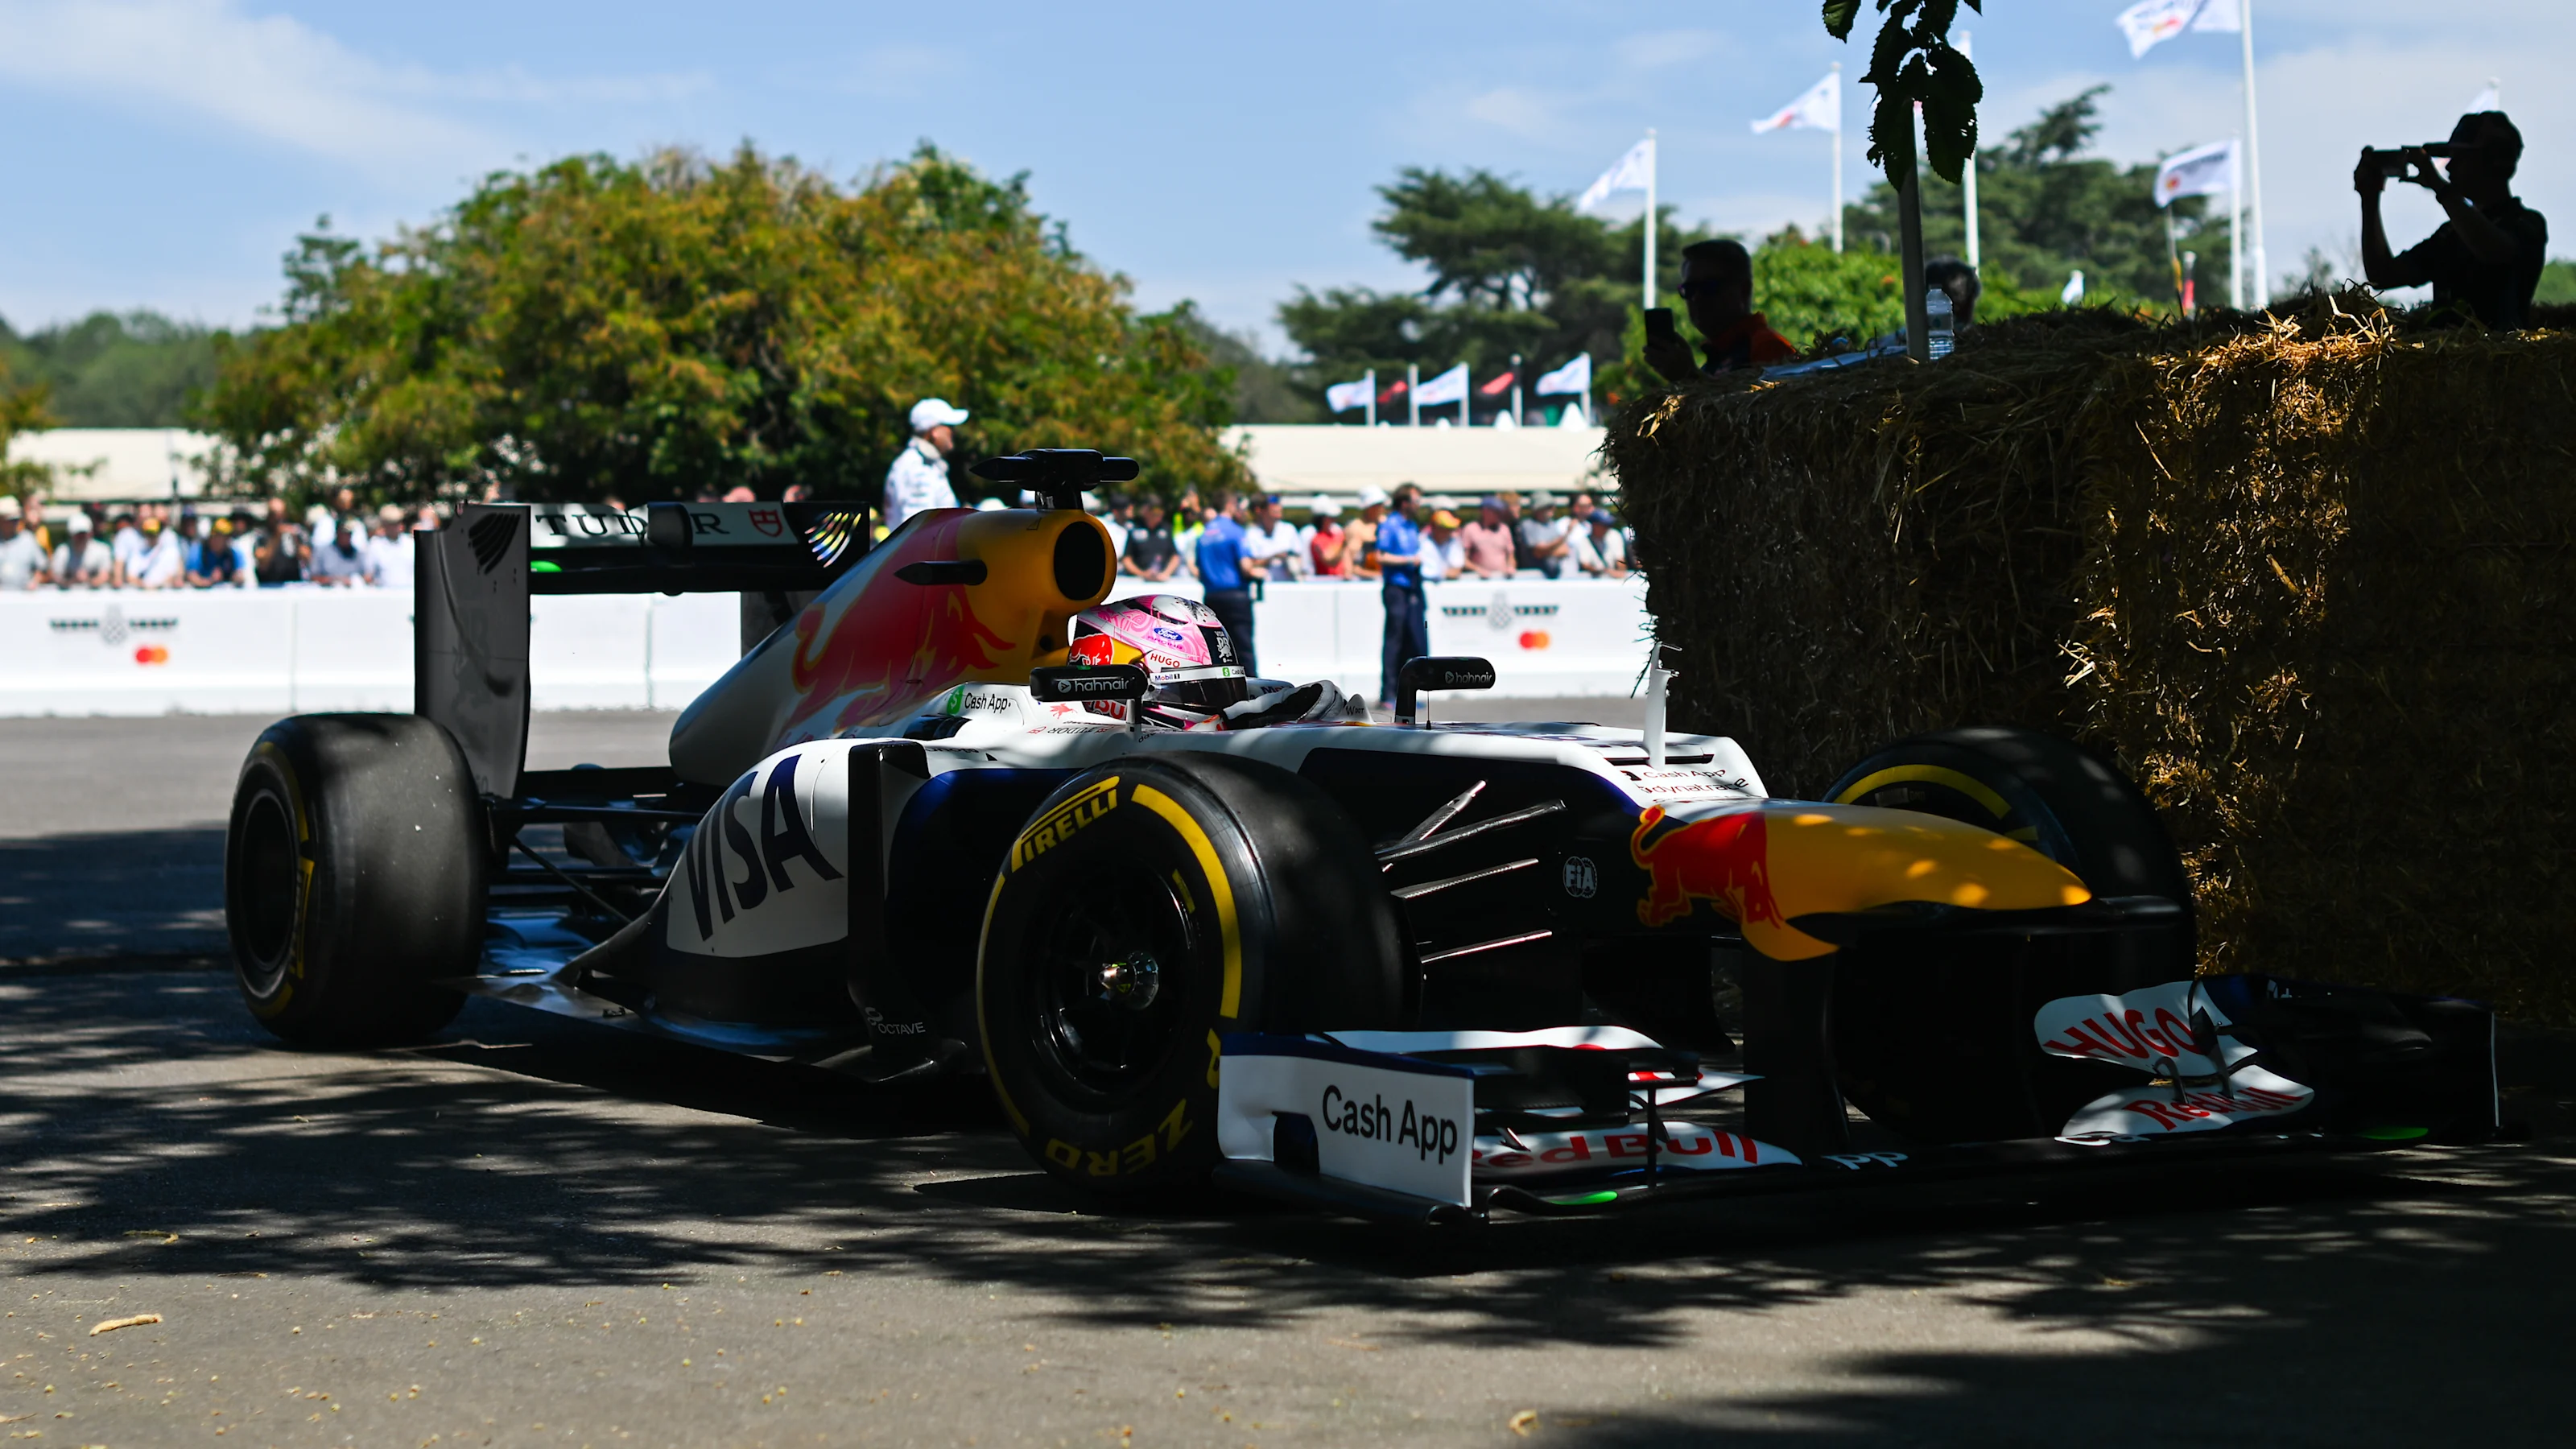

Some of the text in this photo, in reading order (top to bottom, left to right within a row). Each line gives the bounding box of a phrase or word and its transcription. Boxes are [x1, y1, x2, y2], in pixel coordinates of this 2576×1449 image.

[536, 512, 731, 537] TUDR
[1158, 628, 1179, 641] Ford
[1150, 653, 1180, 668] HUGO
[1075, 678, 1129, 691] hahnair
[1455, 671, 1492, 683] hahnair
[964, 692, 1008, 716] Cash App
[1653, 778, 1748, 793] dynatrace
[1691, 770, 1726, 778] App
[1011, 775, 1121, 873] PIRELLI
[686, 753, 844, 942] VISA
[877, 1022, 927, 1034] OCTAVE
[2043, 1007, 2207, 1060] HUGO
[1323, 1084, 1458, 1165] Cash App
[1045, 1097, 1194, 1177] ZERO
[1473, 1129, 1757, 1168] ed Bull
